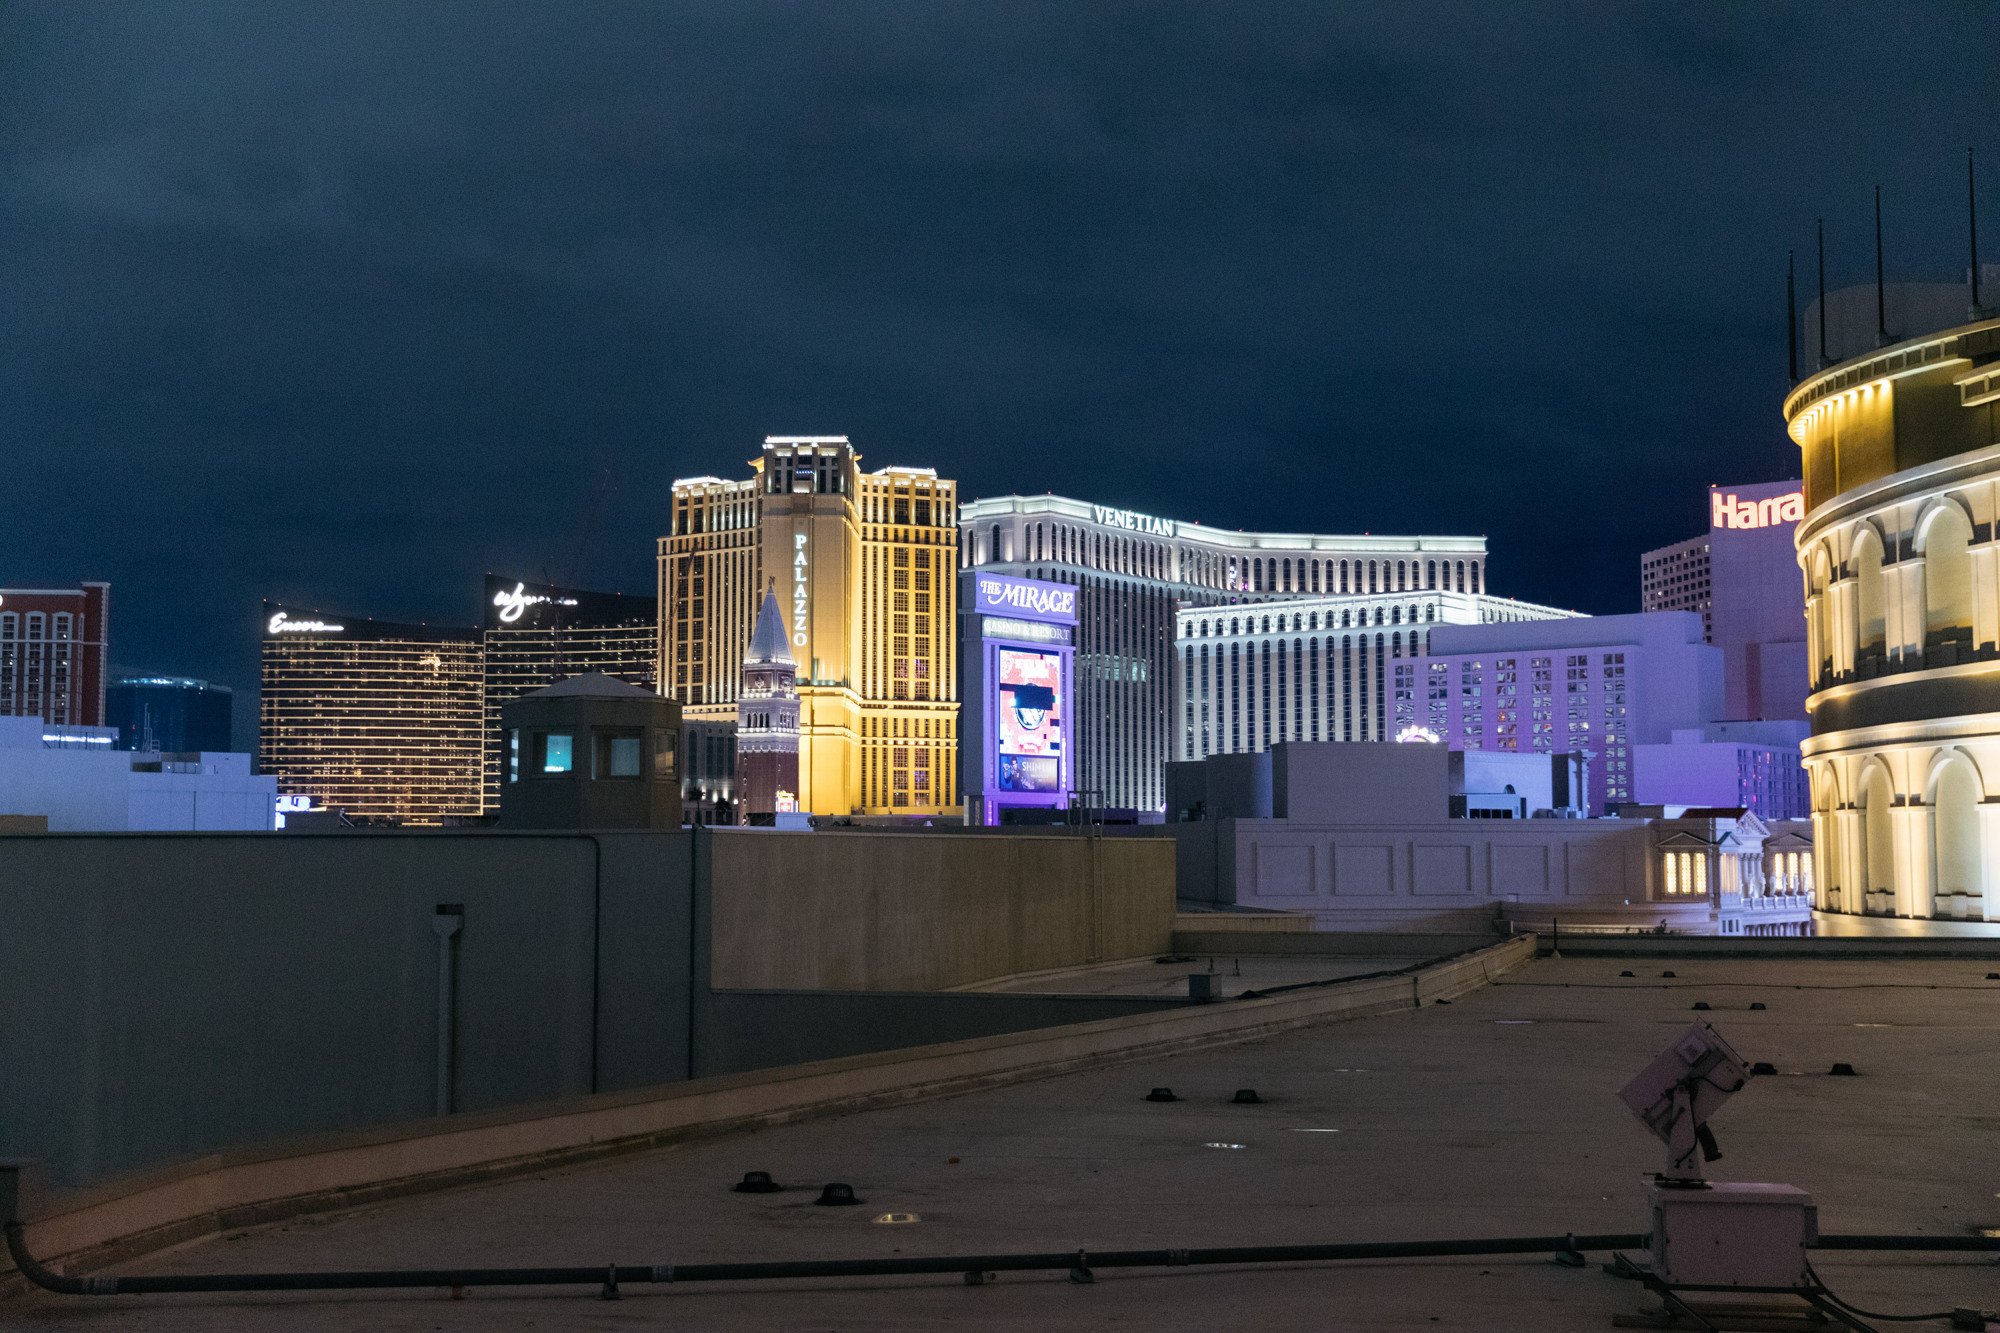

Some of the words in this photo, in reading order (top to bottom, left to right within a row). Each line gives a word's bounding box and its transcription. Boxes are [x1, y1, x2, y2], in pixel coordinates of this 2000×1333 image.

[1093, 504, 1174, 537] VENETIAN
[793, 533, 808, 646] PALAZZO
[980, 581, 1001, 595] THE
[988, 584, 1074, 613] MIRAGE
[983, 619, 1021, 634] CASINO
[1032, 625, 1070, 640] RESORT
